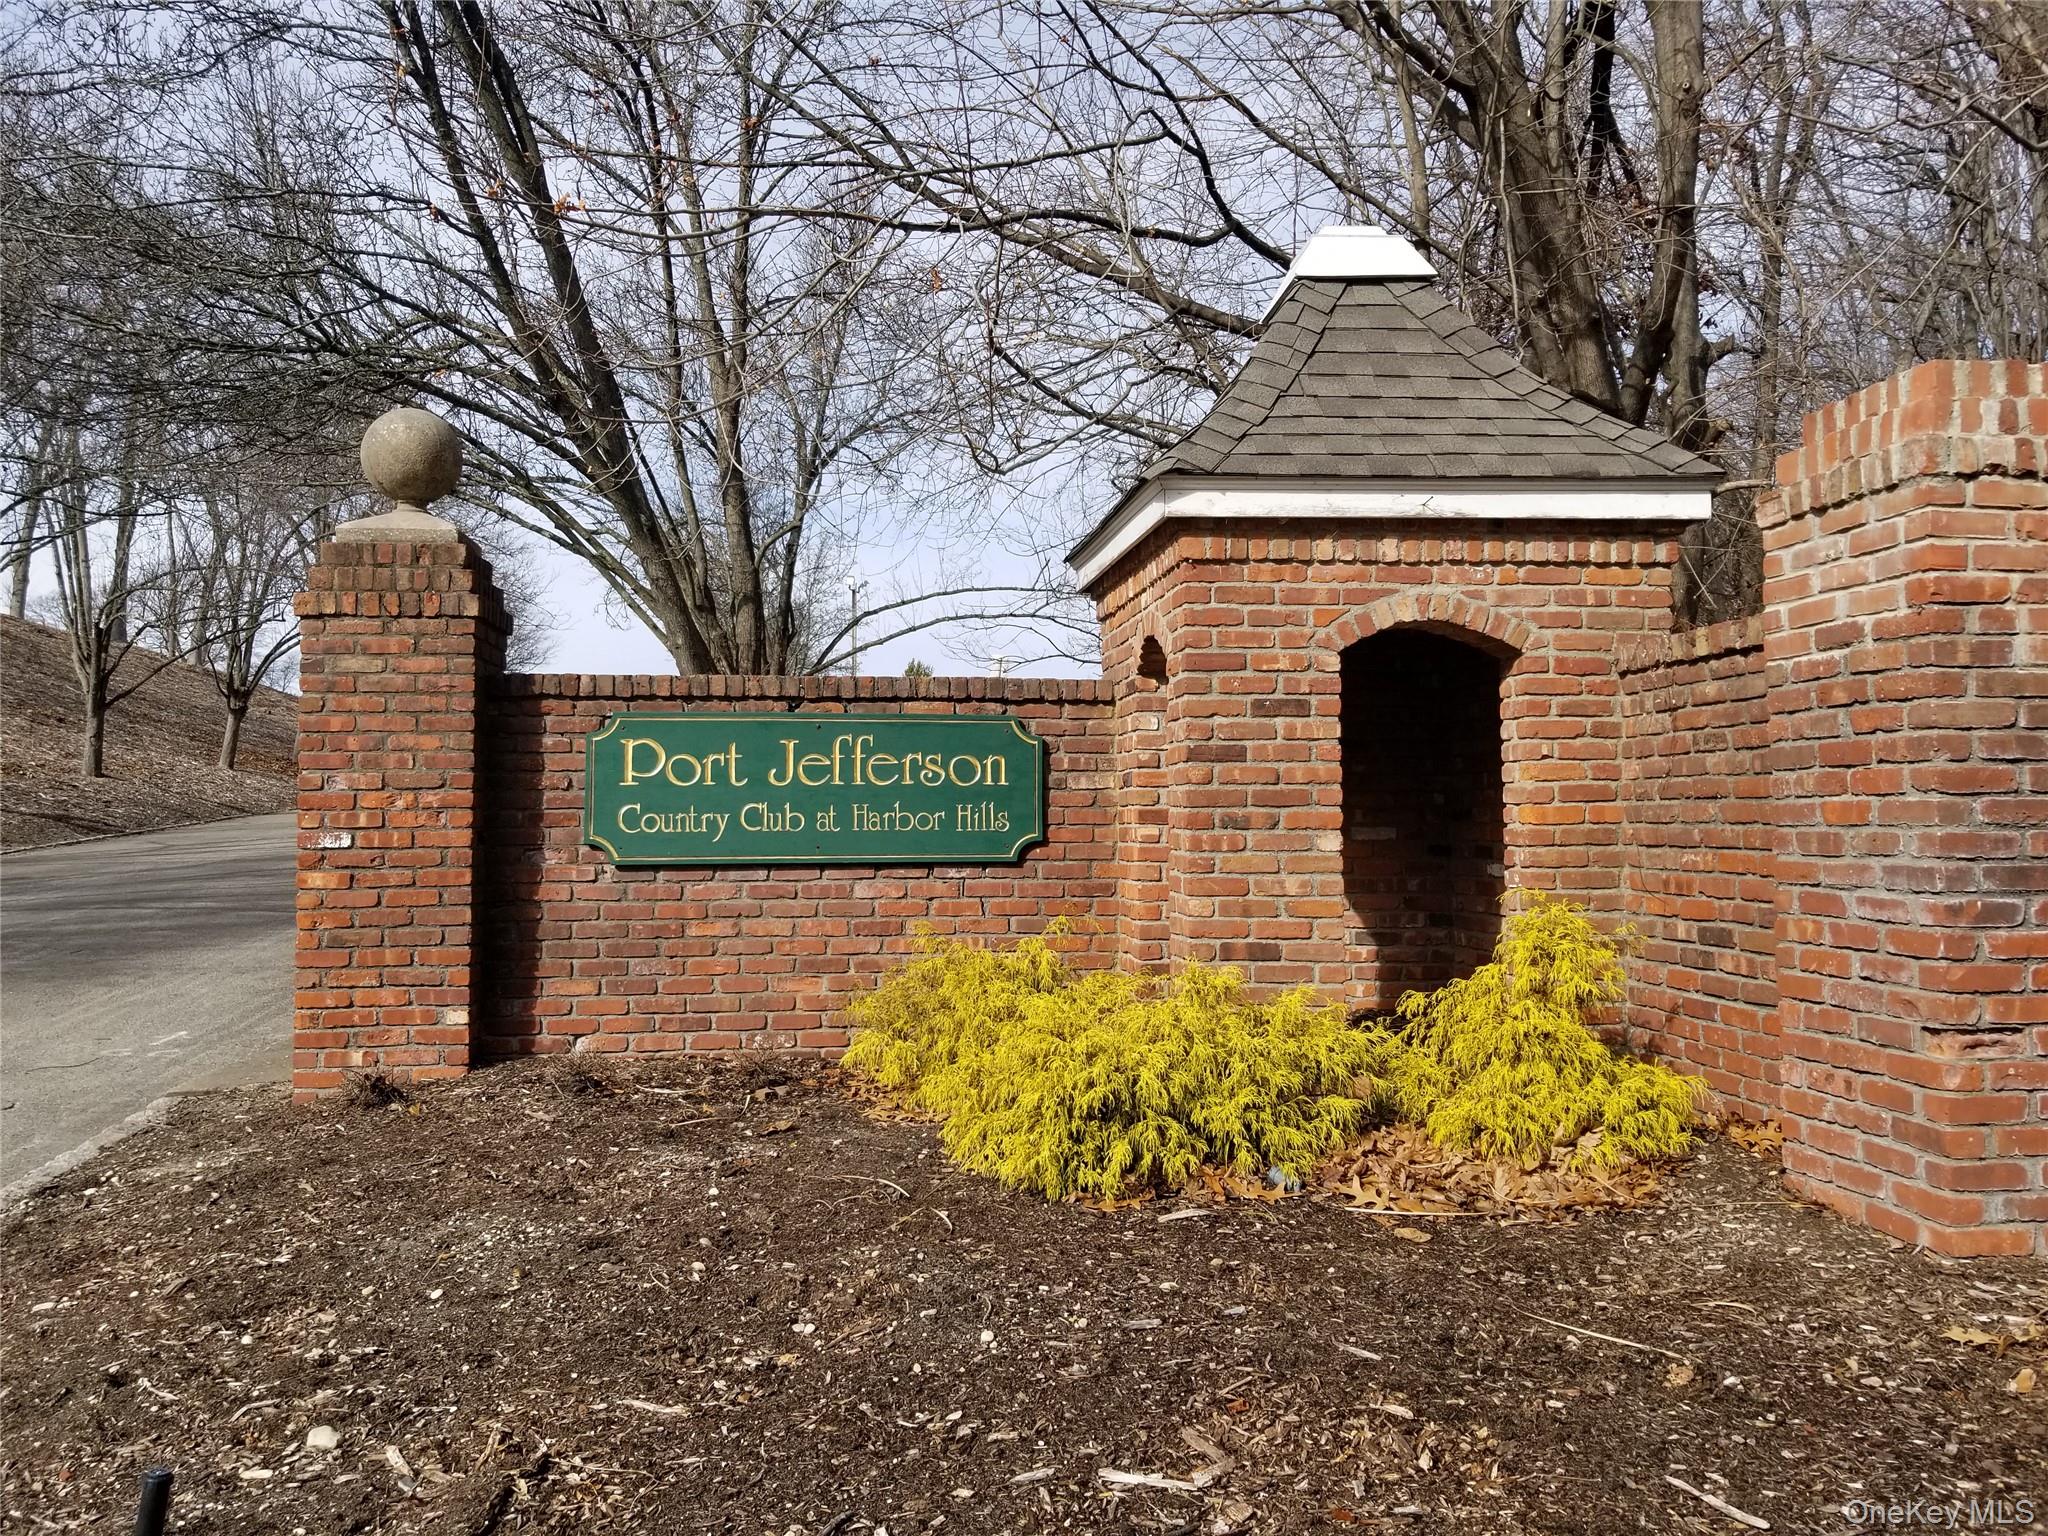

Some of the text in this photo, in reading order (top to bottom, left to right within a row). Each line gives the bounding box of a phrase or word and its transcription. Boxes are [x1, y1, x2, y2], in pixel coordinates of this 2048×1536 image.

[619, 733, 1009, 786] Port Jefferson
[617, 801, 1010, 842] Country Club at Harbor Hills
